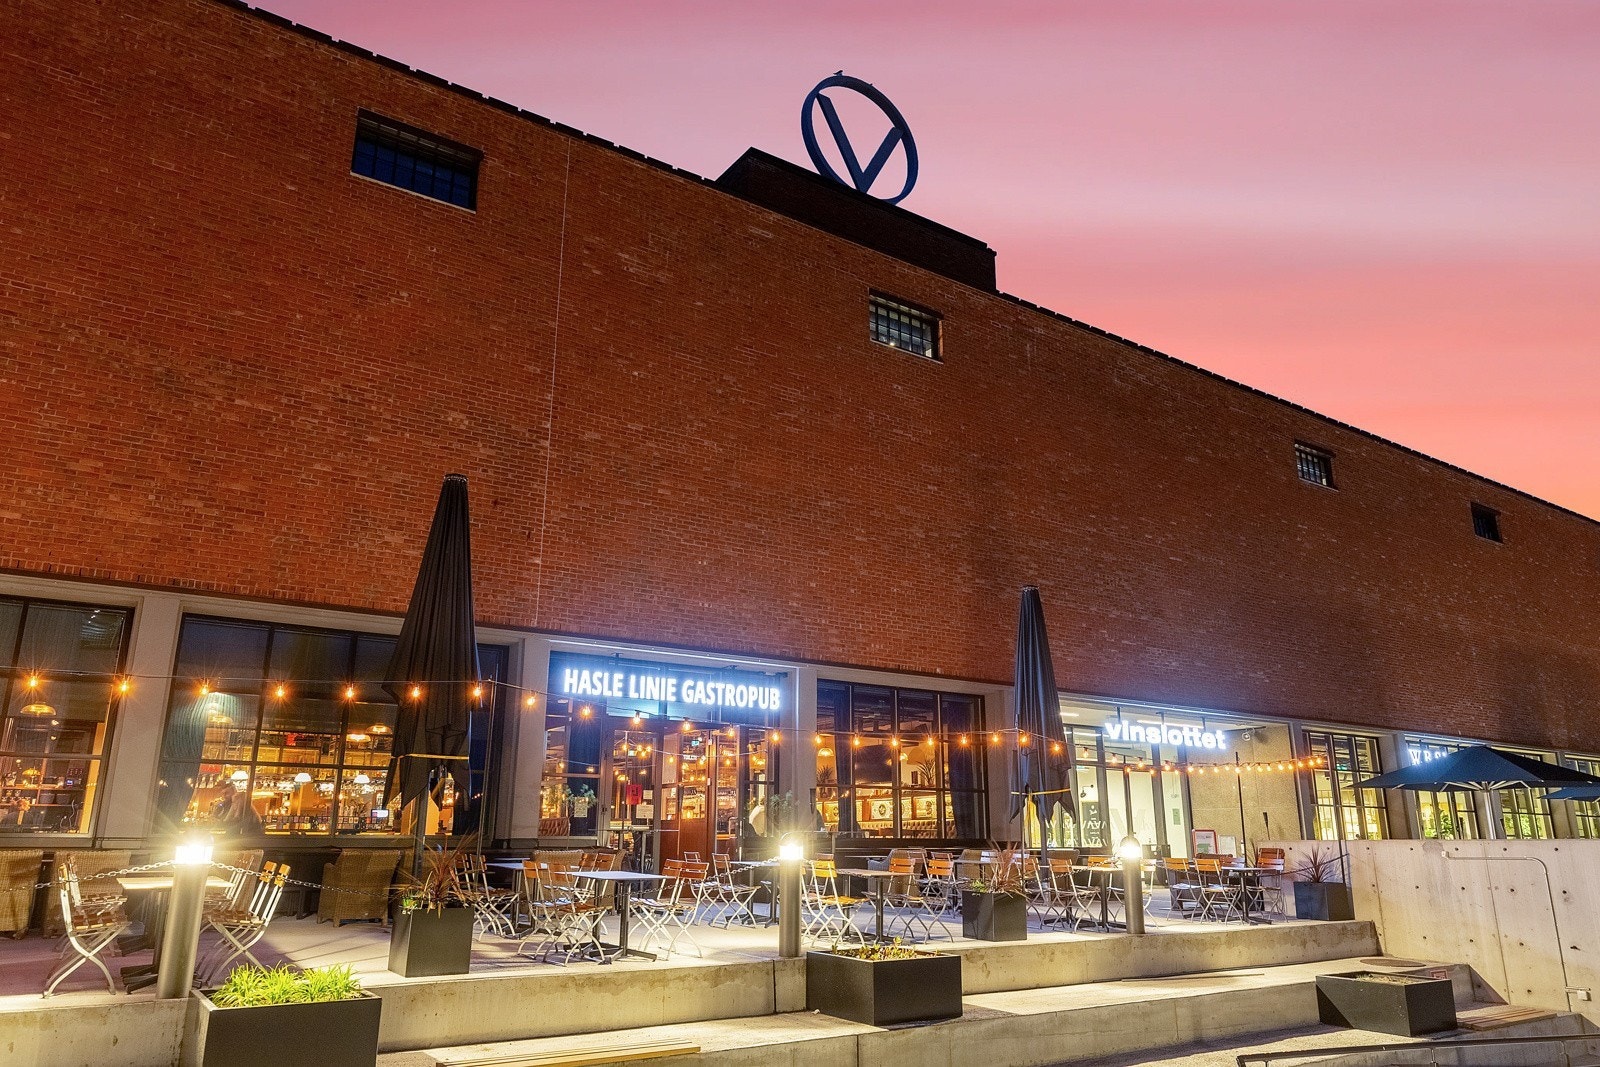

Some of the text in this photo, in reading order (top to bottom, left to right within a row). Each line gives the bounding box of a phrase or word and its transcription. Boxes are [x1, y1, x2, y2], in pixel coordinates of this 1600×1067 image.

[564, 668, 780, 710] HASLE LINIE GASTROPUB
[1105, 720, 1227, 750] vinslottet
